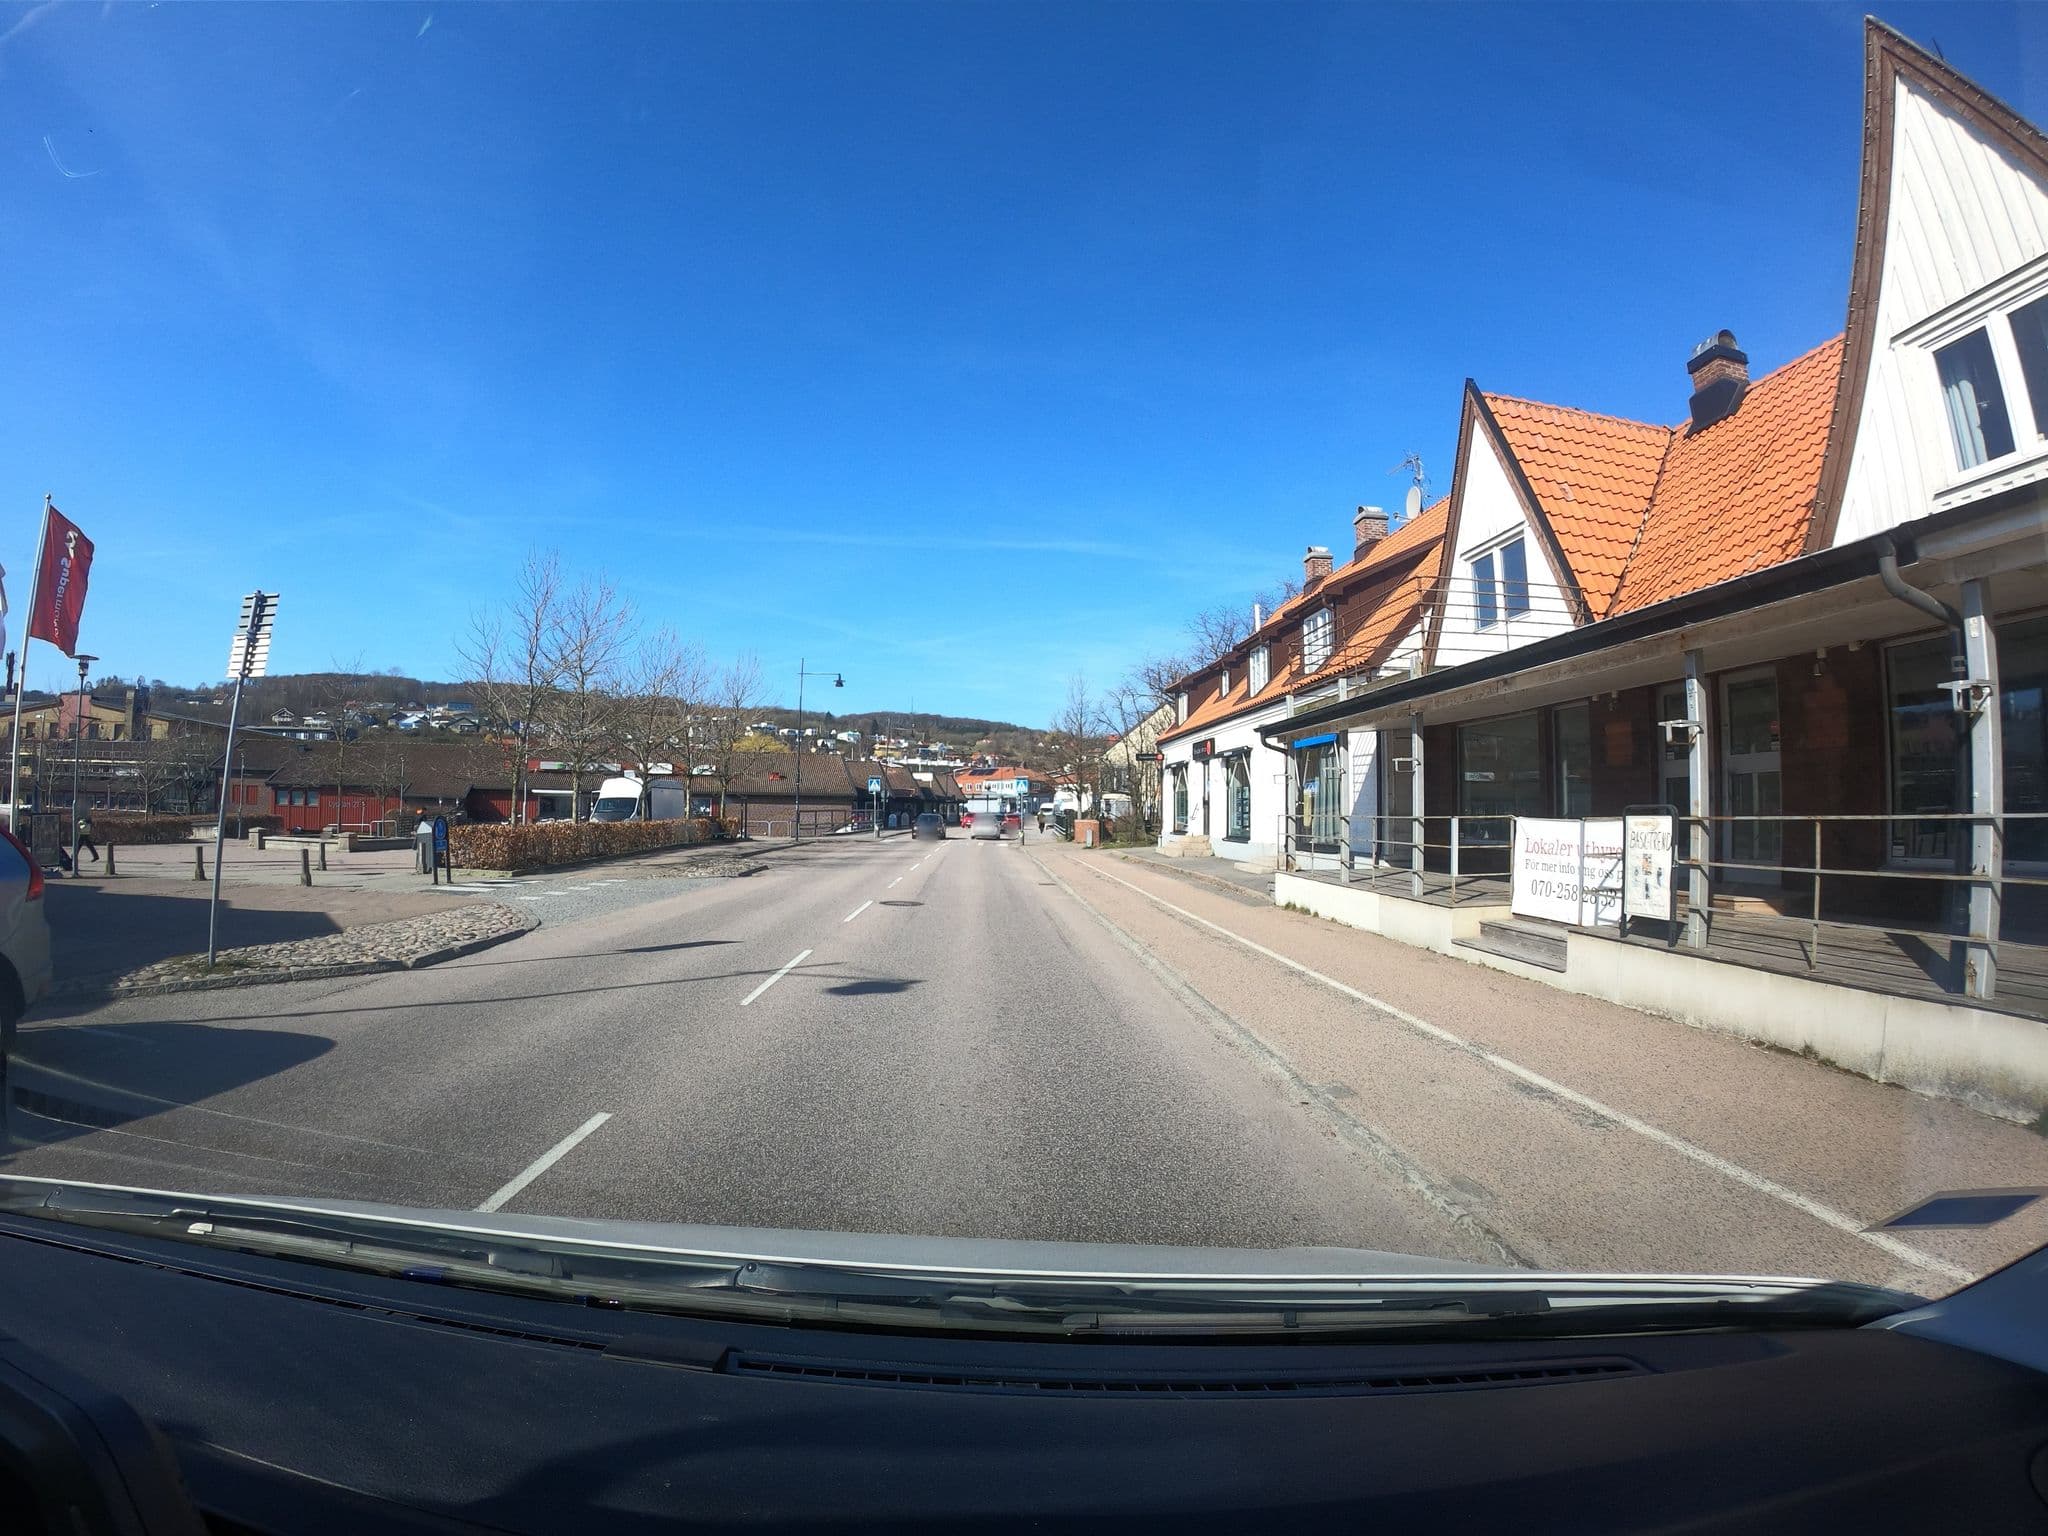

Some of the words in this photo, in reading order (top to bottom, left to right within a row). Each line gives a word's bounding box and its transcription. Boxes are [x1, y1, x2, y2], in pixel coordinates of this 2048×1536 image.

[1525, 837, 1573, 857] Lokaler
[1541, 862, 1557, 873] mer
[1559, 862, 1575, 875] info
[1531, 879, 1578, 902] 070-258
